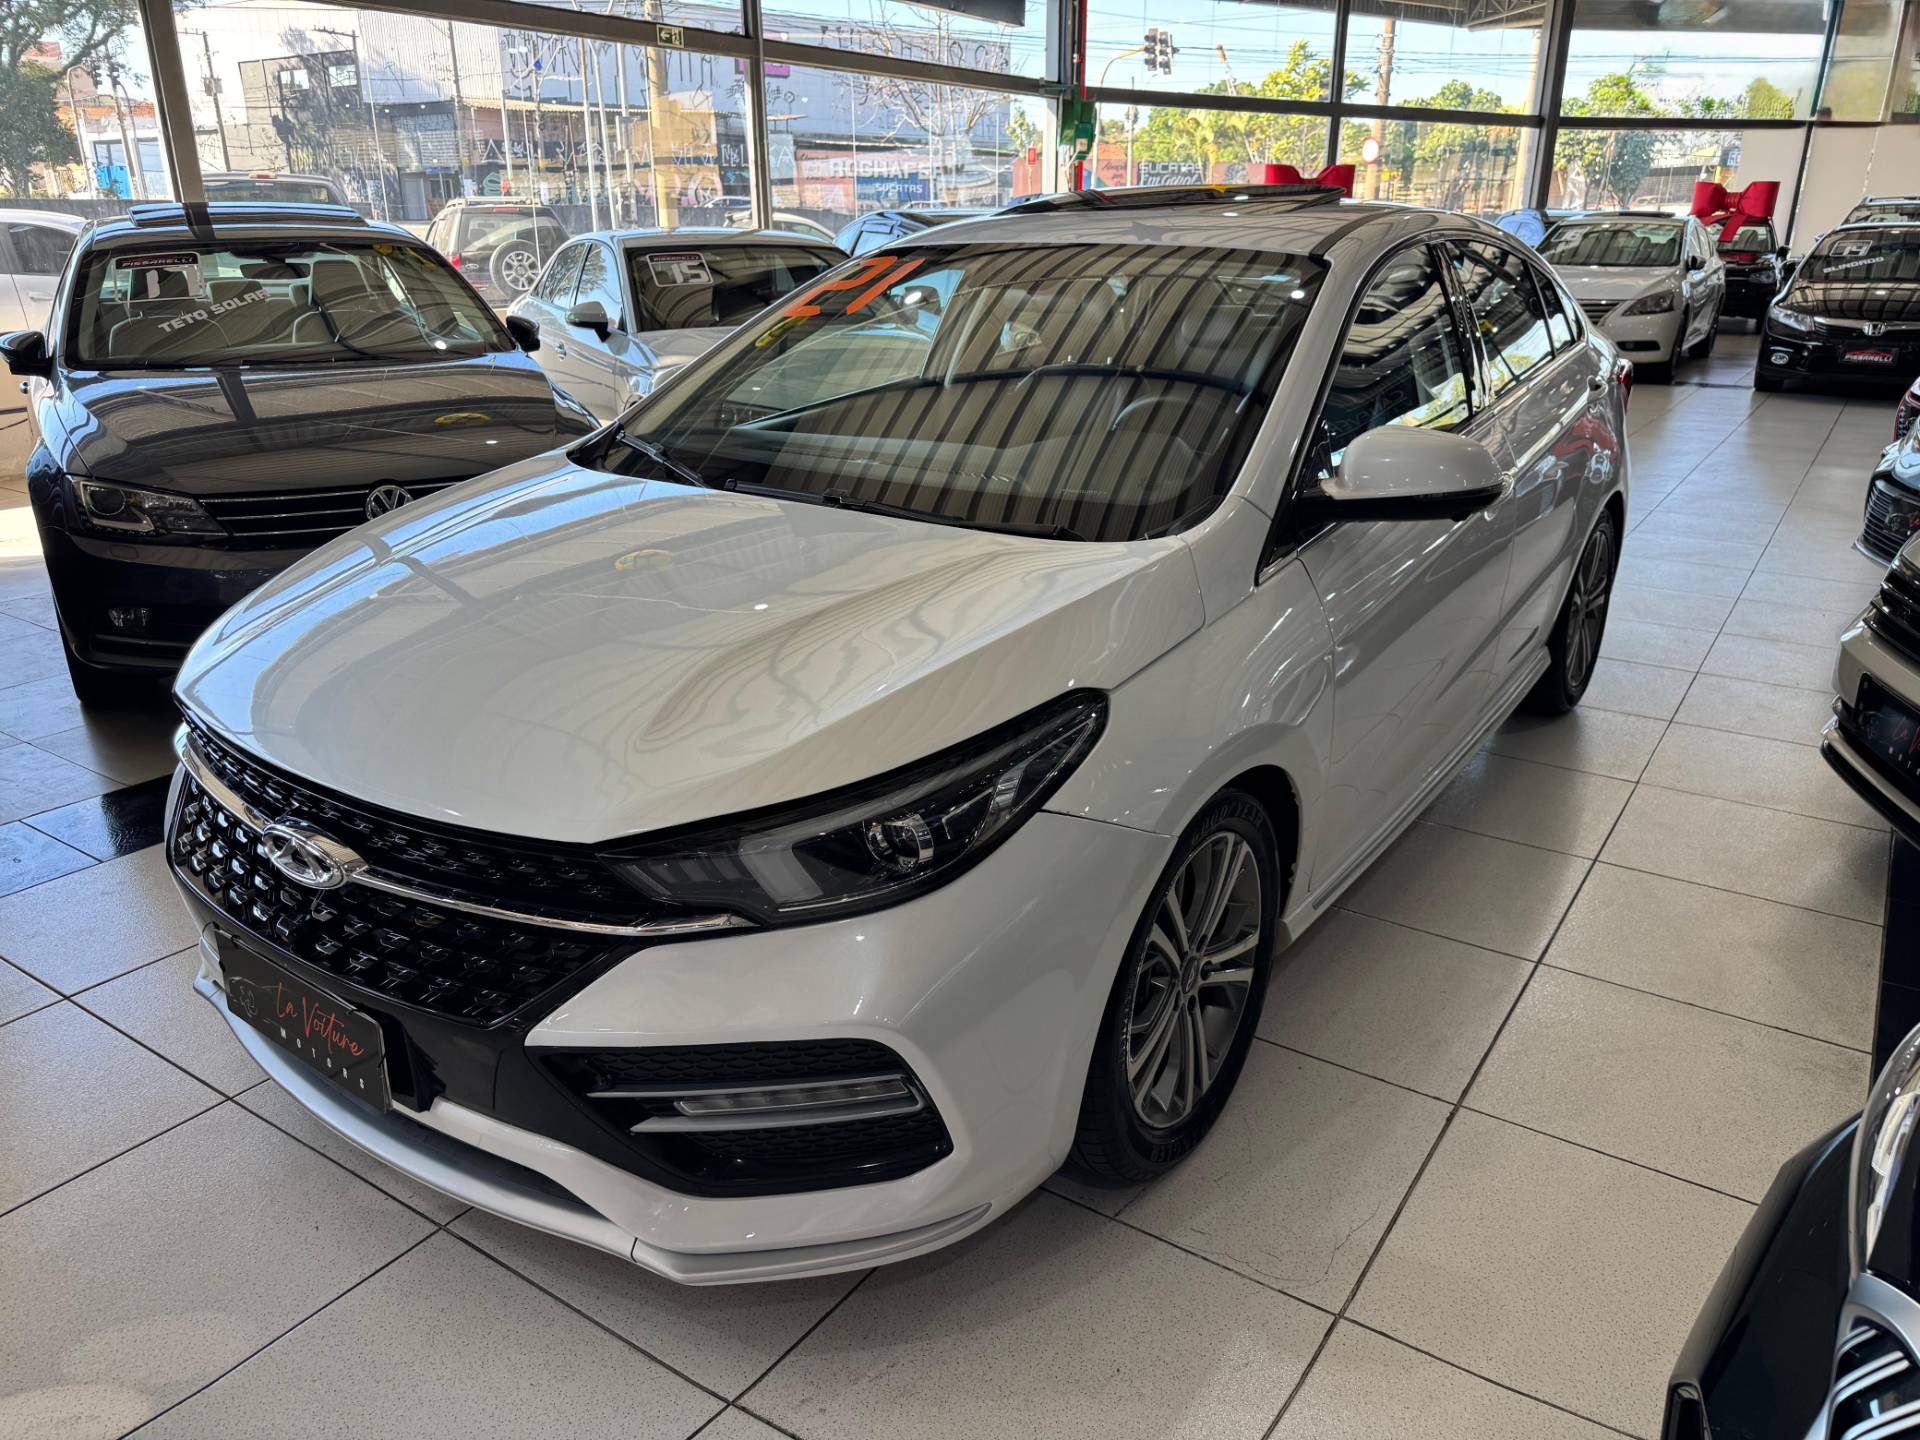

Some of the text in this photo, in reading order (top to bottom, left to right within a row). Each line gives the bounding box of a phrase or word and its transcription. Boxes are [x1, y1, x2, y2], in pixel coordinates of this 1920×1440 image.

[1138, 161, 1203, 174] SUCATAS
[784, 256, 926, 317] 21
[1823, 256, 1884, 274] BLINDADO
[158, 287, 271, 333] TETO SOLAR
[302, 996, 364, 1056] Voiture
